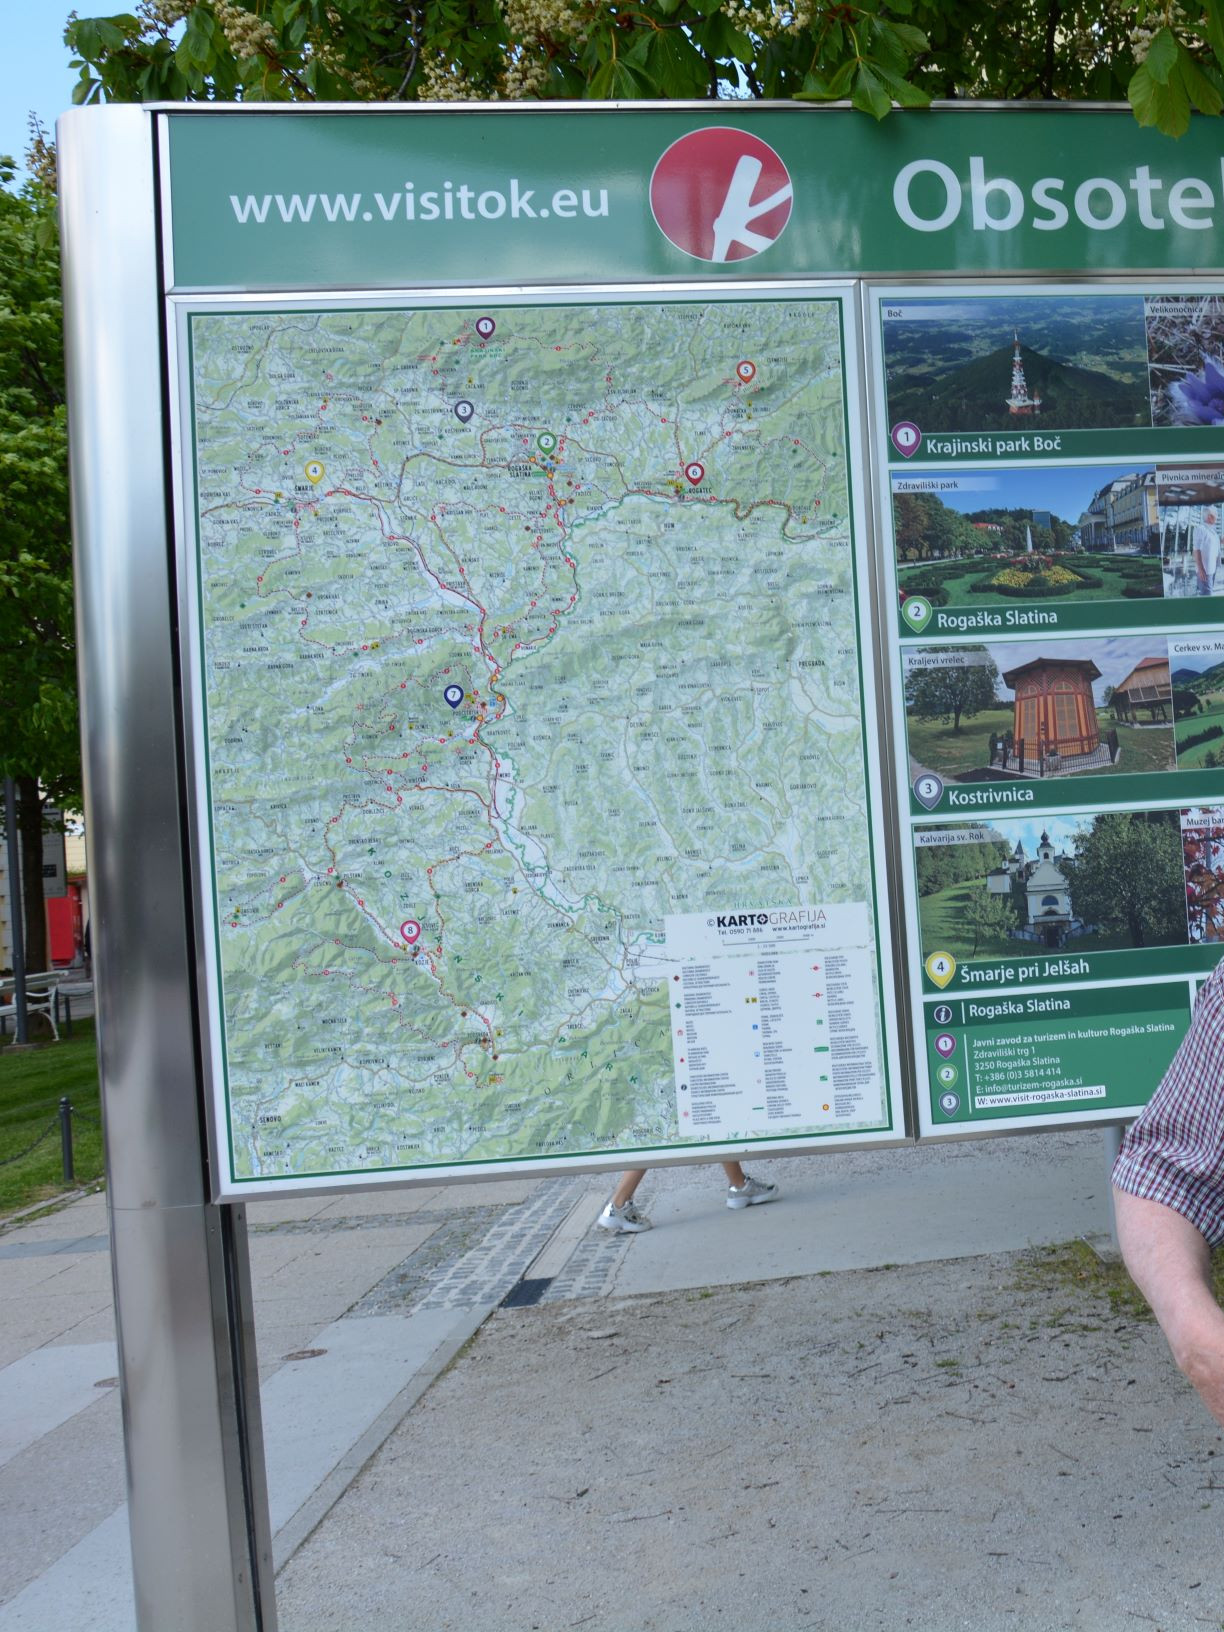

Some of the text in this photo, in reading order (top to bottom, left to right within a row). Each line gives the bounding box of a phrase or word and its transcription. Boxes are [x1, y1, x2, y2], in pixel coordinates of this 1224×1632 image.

[229, 178, 609, 224] www.visitok.eu
[886, 308, 903, 319] Boč
[903, 431, 910, 443] 1
[926, 436, 1062, 456] Krajinski park Boč
[1161, 471, 1189, 483] Pivnica
[897, 479, 960, 492] Zdraviliški park
[914, 606, 922, 617] 2
[937, 609, 1058, 631] Rogaška Slatina
[1174, 644, 1201, 653] Cerkev
[1202, 644, 1212, 652] sv.
[908, 656, 965, 667] Kraljevi vrelec
[925, 783, 932, 794] 3
[948, 787, 1034, 806] Kostrivnica
[1186, 815, 1209, 827] Muzej
[919, 831, 985, 845] Kalvarija sv. Rok
[716, 908, 827, 928] KARTOGRAFIJA
[937, 962, 944, 973] 4
[960, 959, 1090, 984] Šmarje pri Jelšah
[969, 998, 1071, 1019] Rogaška Slatina
[972, 1037, 995, 1048] Javni
[996, 1035, 1021, 1046] zavod
[1034, 1032, 1066, 1043] turizem
[1068, 1031, 1076, 1039] in
[1078, 1029, 1108, 1039] kulturo
[1109, 1025, 1145, 1037] Rogaška
[1146, 1023, 1175, 1033] Slatina
[973, 1047, 1016, 1059] Zdraviliški
[1017, 1048, 1029, 1057] trg
[975, 1056, 1060, 1071] 3250 Rogaška Slatina
[975, 1074, 983, 1083] T:
[984, 1071, 1005, 1081] +386
[1024, 1068, 1044, 1078] 5814
[1046, 1067, 1061, 1076] 414
[976, 1076, 1083, 1094] E: info@turizem-rogaska.si
[977, 1086, 1102, 1106] W: www.visit-rogaska-slatina.si
